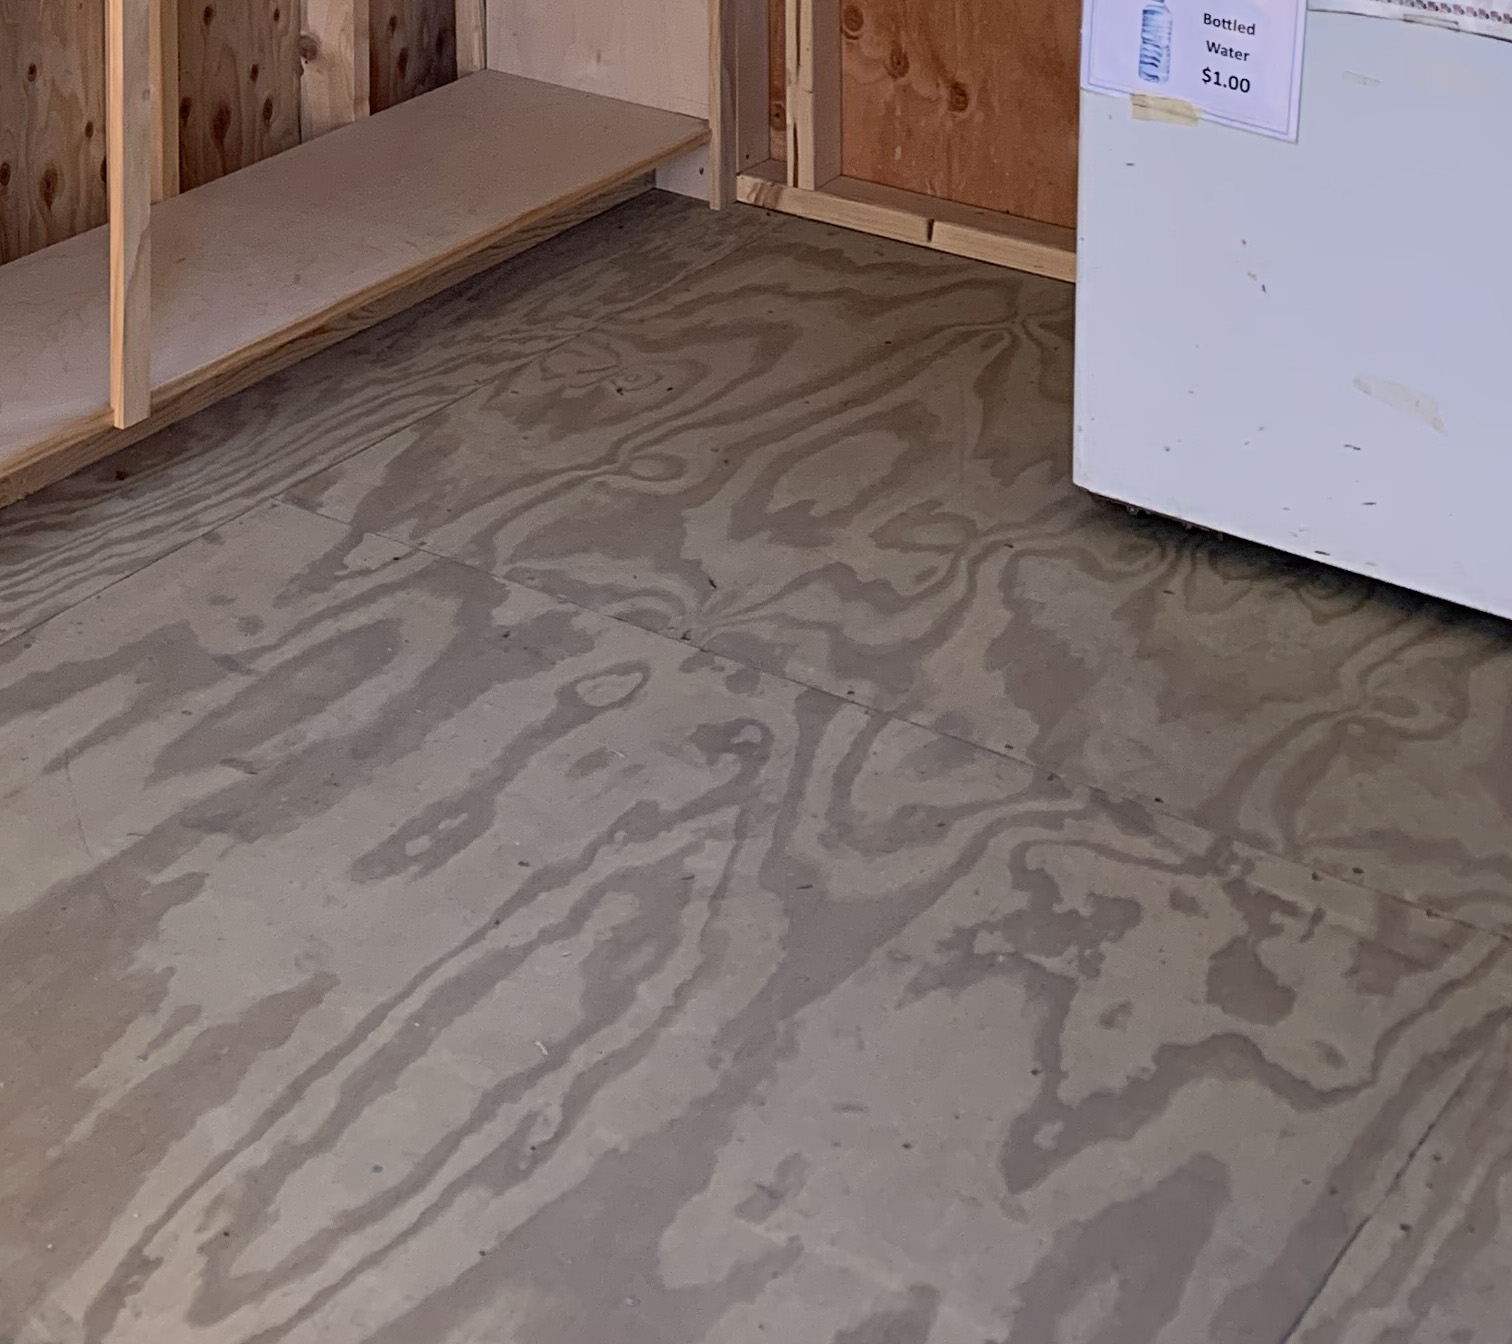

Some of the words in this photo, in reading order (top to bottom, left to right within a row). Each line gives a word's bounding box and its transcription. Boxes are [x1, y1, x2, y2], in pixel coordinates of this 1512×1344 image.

[1203, 12, 1256, 36] Bottled
[1206, 40, 1250, 62] Water
[1202, 66, 1251, 93] $1.00
